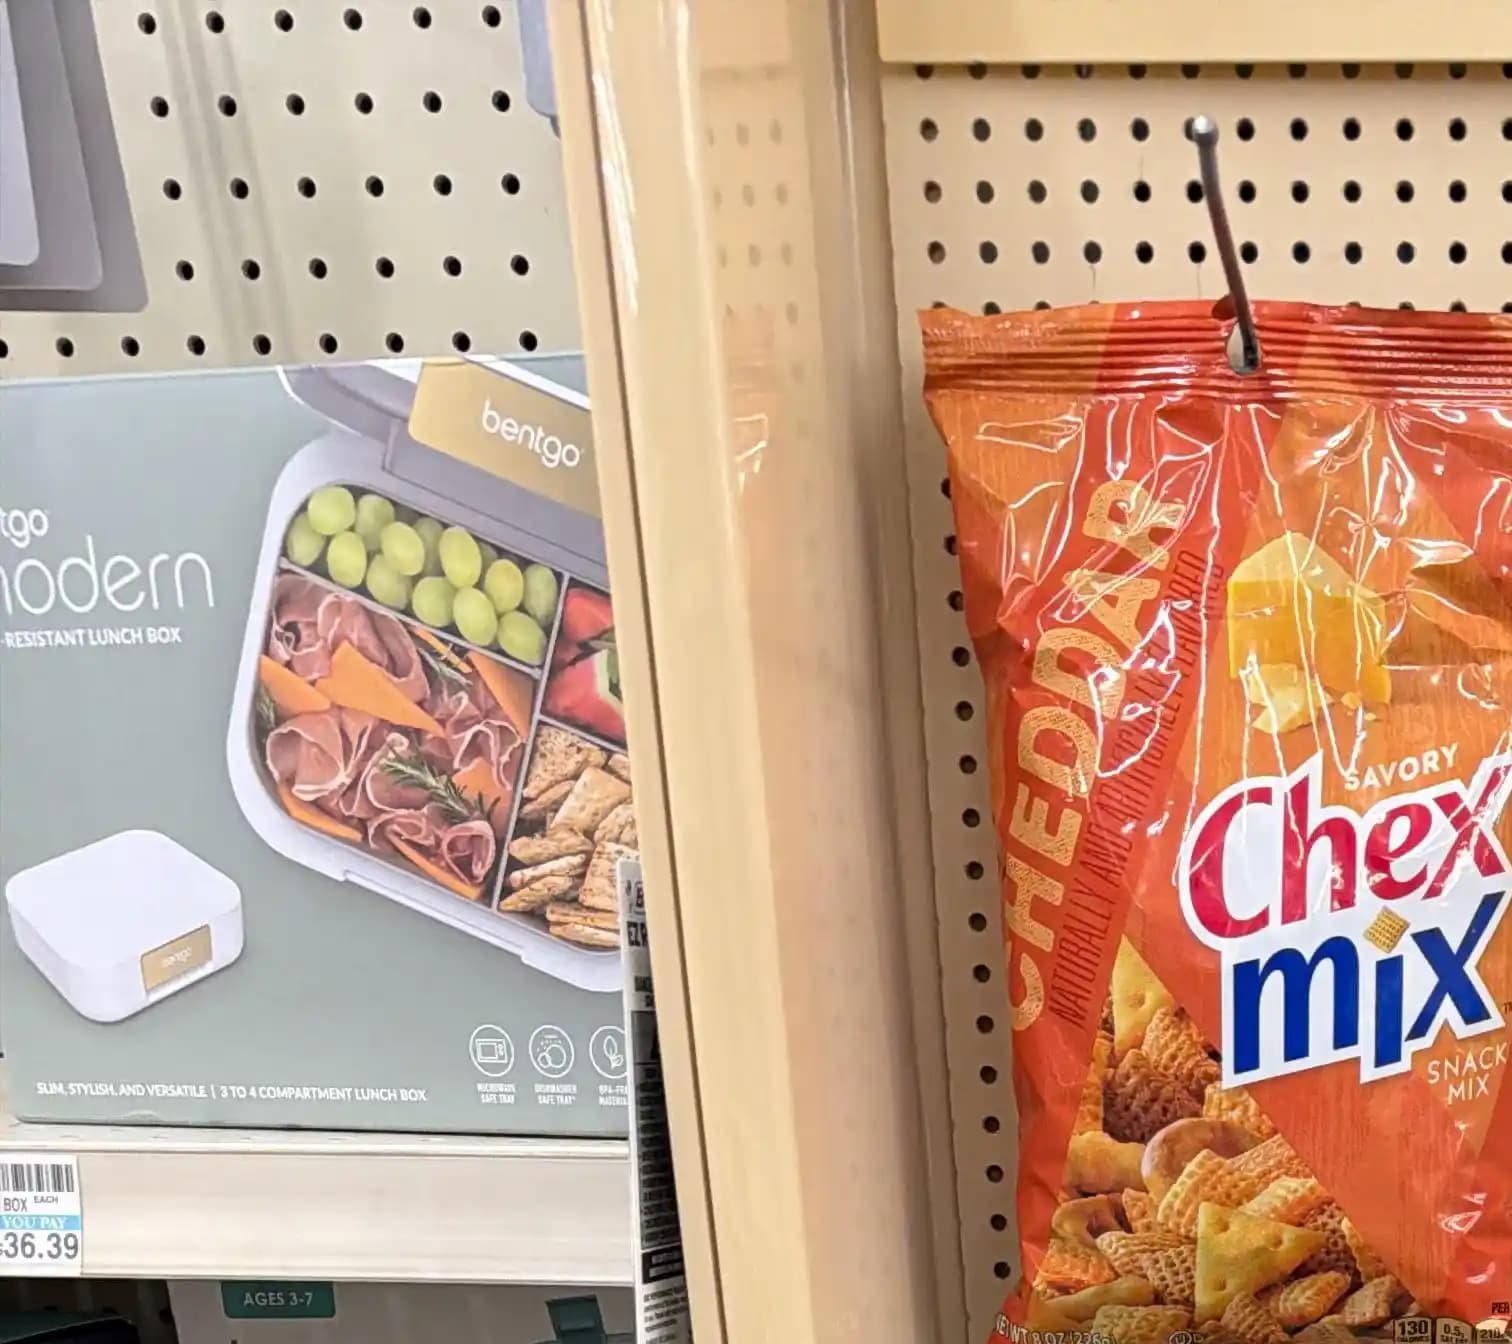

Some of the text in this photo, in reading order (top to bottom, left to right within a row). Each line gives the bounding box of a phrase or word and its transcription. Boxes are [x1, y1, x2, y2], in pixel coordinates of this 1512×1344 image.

[481, 399, 583, 468] bentgo
[88, 627, 145, 647] LUNCH
[147, 626, 183, 644] BOX
[1004, 479, 1186, 1030] CHEDDAR
[1344, 742, 1459, 792] SAVORY
[1231, 890, 1504, 1076] mix
[1427, 1042, 1507, 1085] SNACK
[1447, 1073, 1490, 1106] MIX
[3, 1197, 28, 1213] BOX
[2, 1216, 68, 1231] YOU PAY
[243, 1292, 313, 1307] AGES 3-7
[1399, 1320, 1430, 1336] 130
